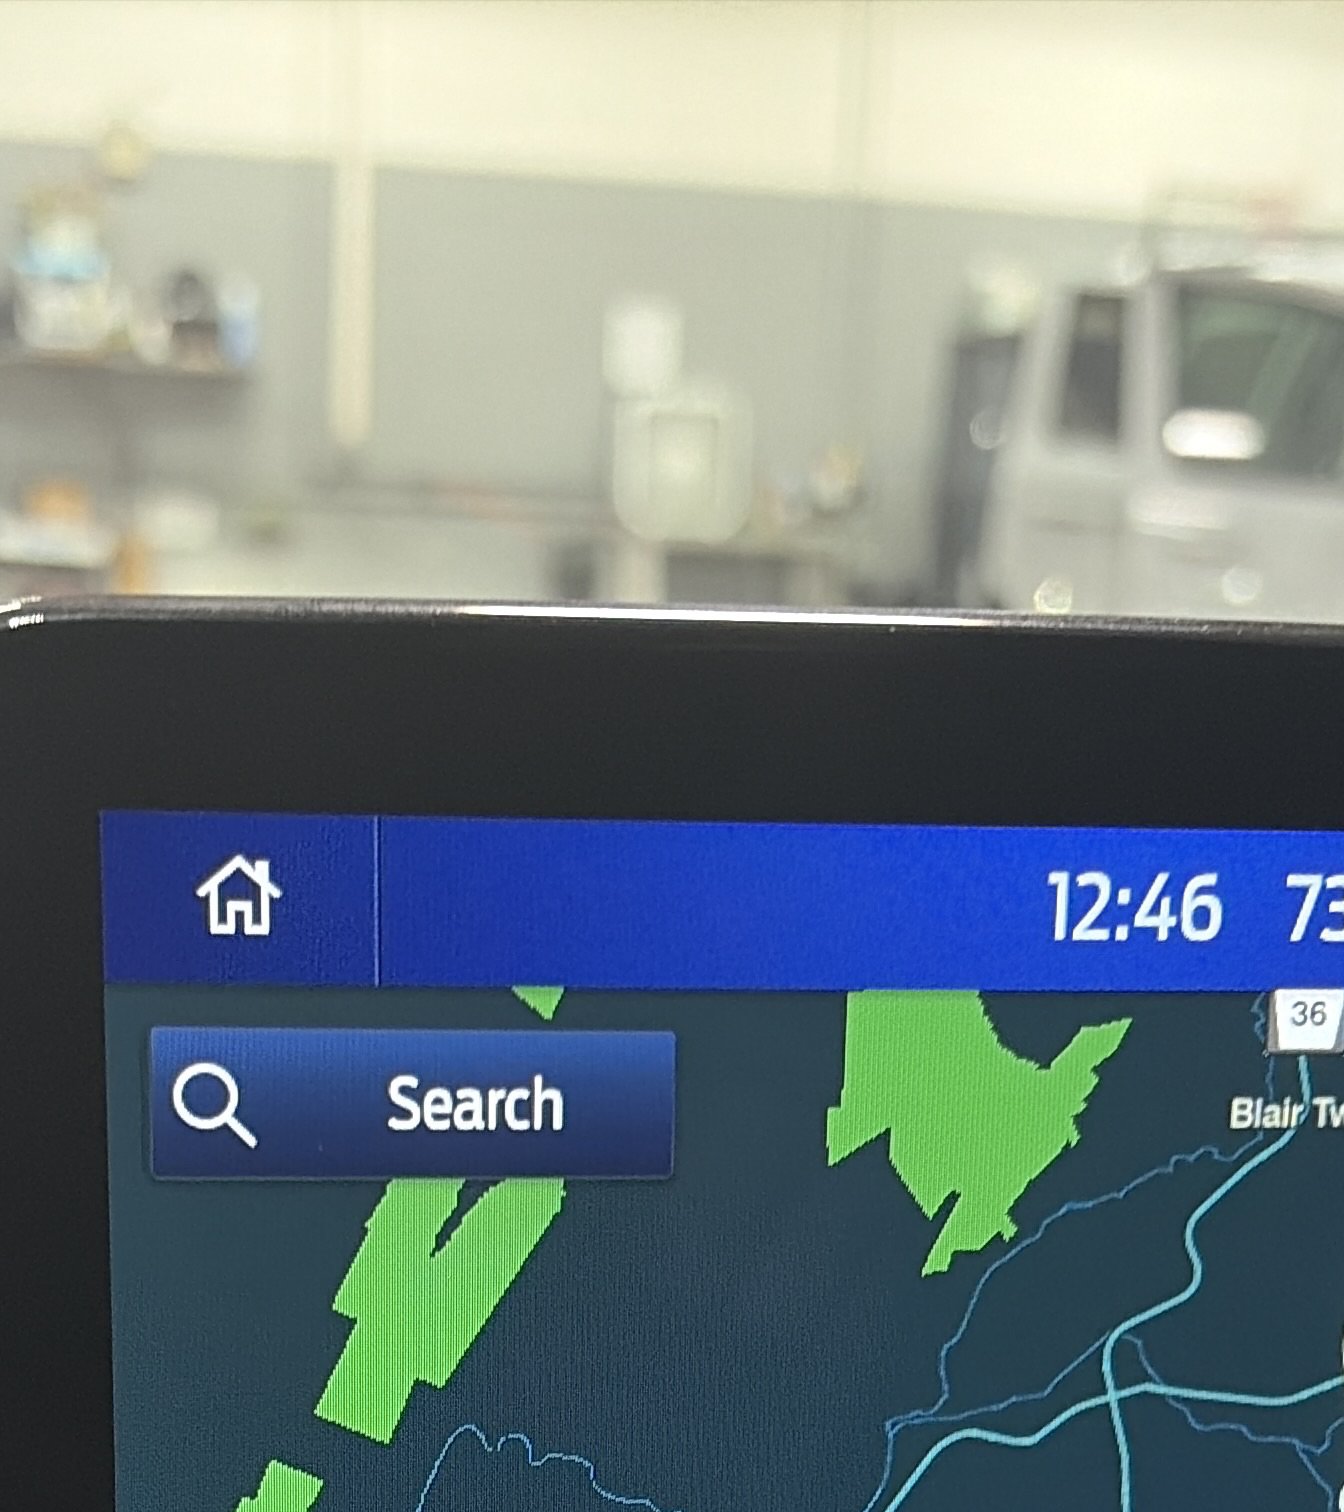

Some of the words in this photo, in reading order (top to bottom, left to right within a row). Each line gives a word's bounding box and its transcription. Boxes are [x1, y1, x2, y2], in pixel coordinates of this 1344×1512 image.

[1047, 871, 1222, 942] 12:46
[1290, 1000, 1327, 1027] 36
[387, 1074, 564, 1132] Search
[1230, 1097, 1304, 1130] Blair
